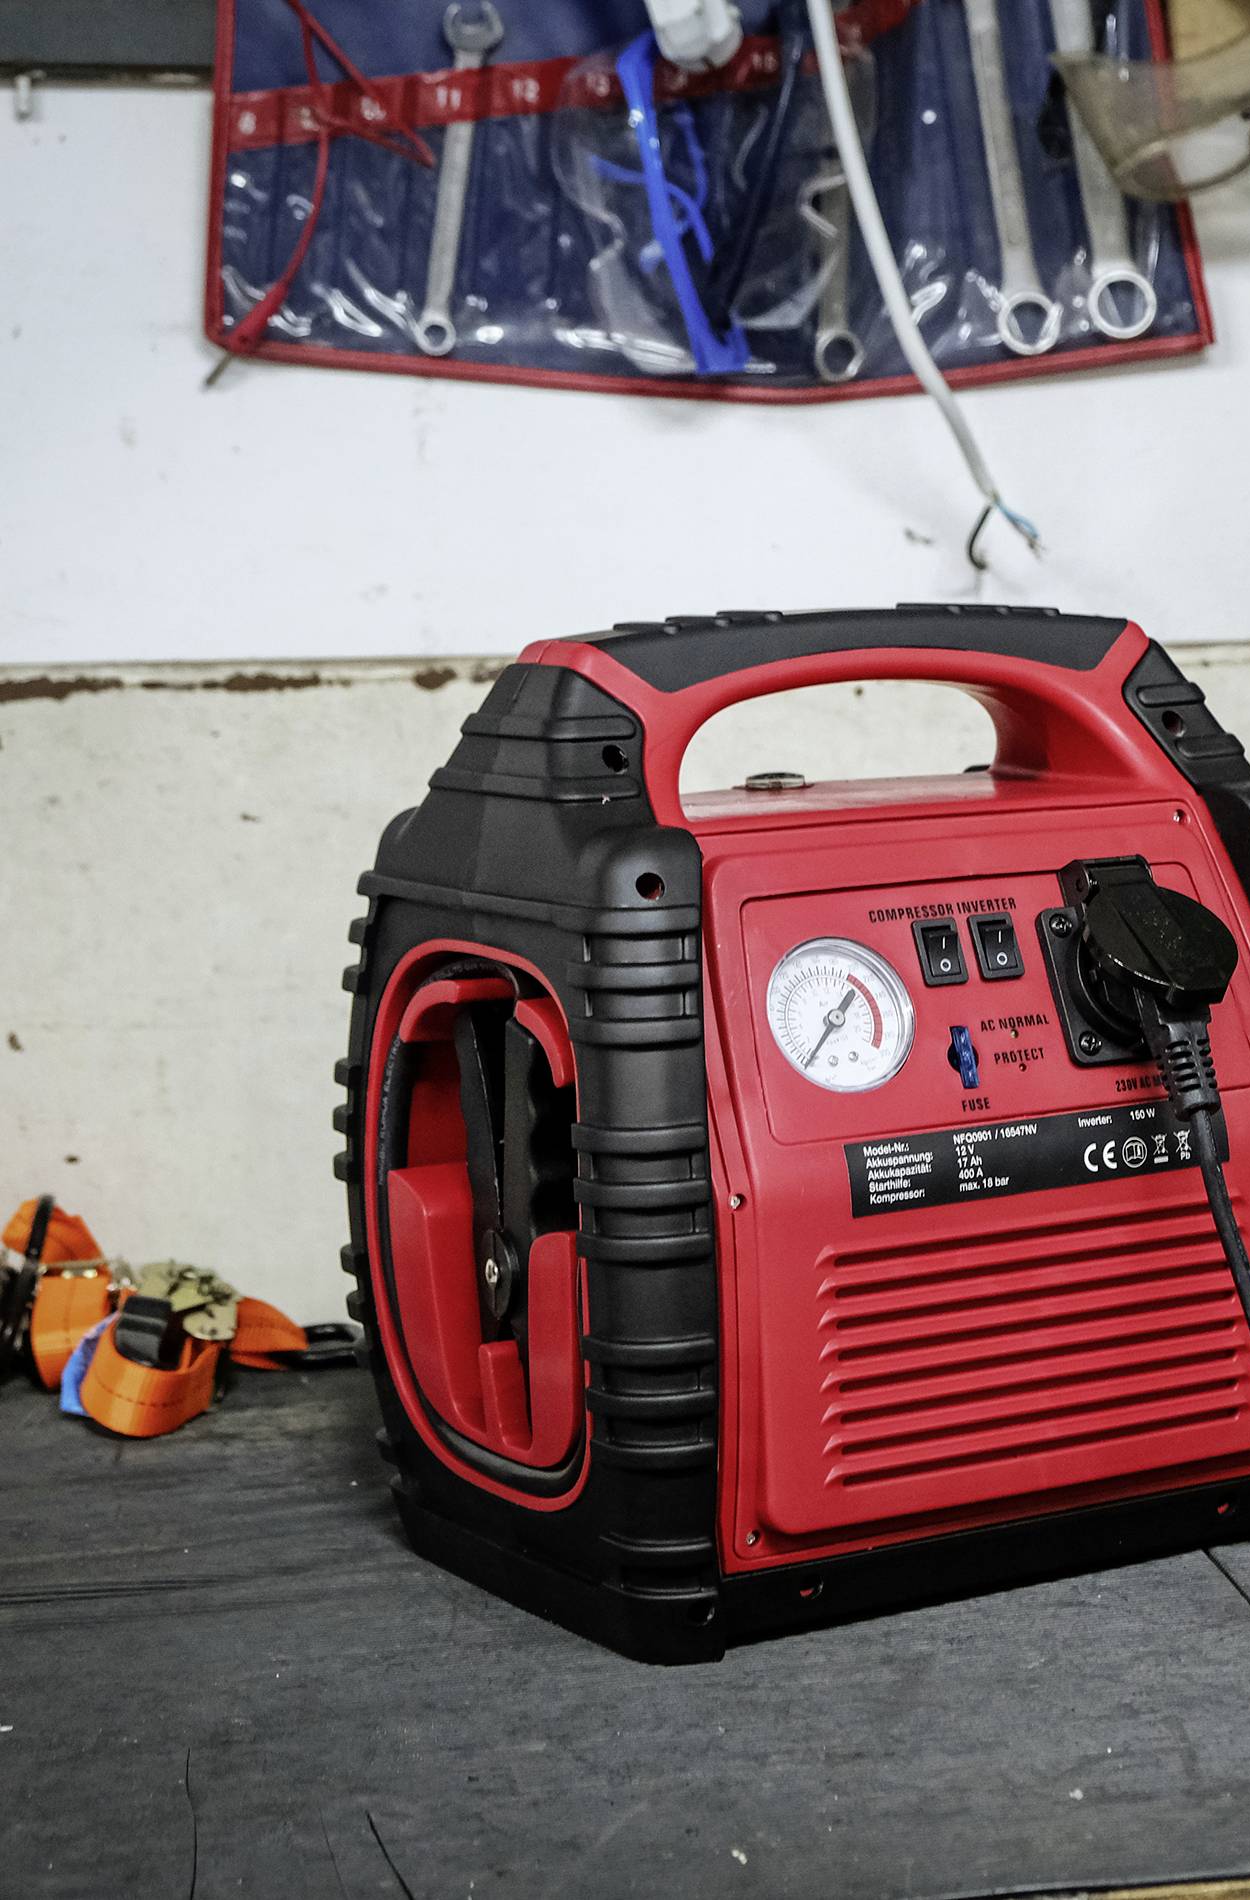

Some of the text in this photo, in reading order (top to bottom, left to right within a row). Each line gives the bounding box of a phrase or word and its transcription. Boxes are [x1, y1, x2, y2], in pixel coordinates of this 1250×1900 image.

[436, 85, 462, 109] 11
[868, 897, 1017, 923] COMPRESSOR INVERTER
[980, 1014, 1049, 1032] AC NORMAL
[993, 1047, 1045, 1064] PROTECT
[1115, 1079, 1138, 1092] 230V
[1139, 1077, 1151, 1089] AC
[961, 1097, 991, 1112] FUSE
[1078, 1115, 1113, 1128] Inverter:
[1145, 1108, 1156, 1119] W
[863, 1142, 910, 1158] Model-Nr.:
[953, 1131, 993, 1145] NFQ0901
[866, 1144, 975, 1169] Akkuspannung: 12 V
[867, 1156, 983, 1180] Akkukapazität: 17 Ah
[869, 1168, 984, 1193] Starthilfe: 400 A
[870, 1176, 1010, 1205] Kompressor: max. 18 bar
